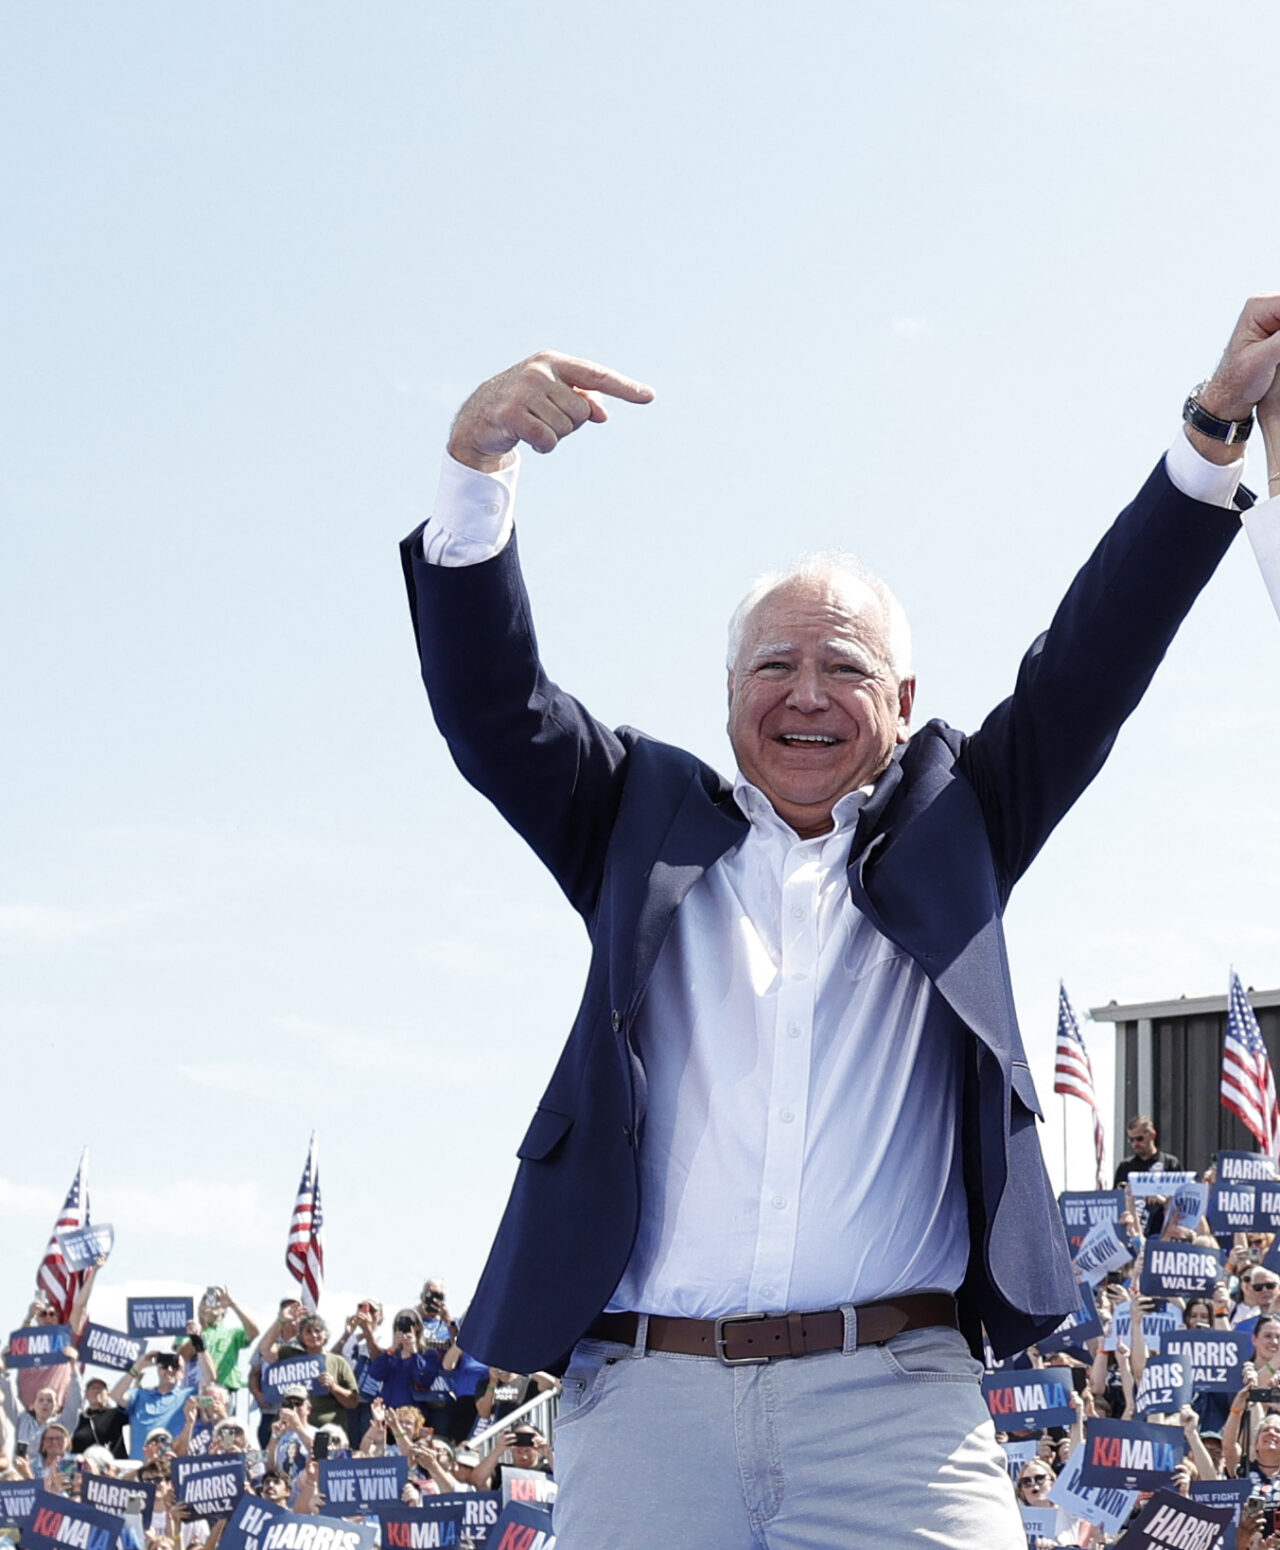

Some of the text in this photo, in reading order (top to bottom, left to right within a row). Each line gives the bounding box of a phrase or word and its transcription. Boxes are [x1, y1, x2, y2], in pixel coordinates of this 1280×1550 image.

[1222, 1158, 1276, 1180] HARRIS
[1218, 1191, 1255, 1213] HAR
[1065, 1206, 1087, 1225] WE
[1089, 1205, 1118, 1224] WIN
[1227, 1213, 1254, 1225] WA
[1077, 1251, 1098, 1272] WE
[1091, 1236, 1118, 1264] WIN
[1152, 1251, 1217, 1278] HARRIS
[1162, 1276, 1206, 1290] WALZ
[133, 1311, 187, 1328] WE WIN
[1054, 1307, 1093, 1334] ALA
[1116, 1317, 1176, 1336] W WIN
[12, 1333, 65, 1356] KAMALA
[86, 1329, 141, 1361] HARRIS
[1167, 1342, 1238, 1367] HARRIS
[92, 1350, 129, 1368] WALZ
[269, 1360, 320, 1386] HARRIS
[1136, 1363, 1184, 1398] ARRIS
[1191, 1368, 1228, 1382] ALZ
[277, 1381, 313, 1395] WZ
[988, 1383, 1067, 1415] KAMALA
[1092, 1436, 1174, 1472] KAMALA
[328, 1470, 354, 1478] WHEN
[371, 1467, 397, 1477] FIGHT
[184, 1473, 238, 1503] HARRIS
[327, 1477, 398, 1502] WE WIN
[511, 1479, 551, 1503] KAM
[1195, 1492, 1240, 1502] WE FIGHT
[193, 1499, 234, 1514] WALZ
[1094, 1487, 1129, 1518] WIN
[33, 1508, 110, 1550] KAMALA
[263, 1523, 361, 1550] HARRIS
[387, 1521, 455, 1549] KAMALA
[460, 1527, 487, 1540] LZ
[498, 1522, 557, 1550] KAM
[1024, 1521, 1043, 1531] OTE
[1143, 1504, 1221, 1550] HARRIS
